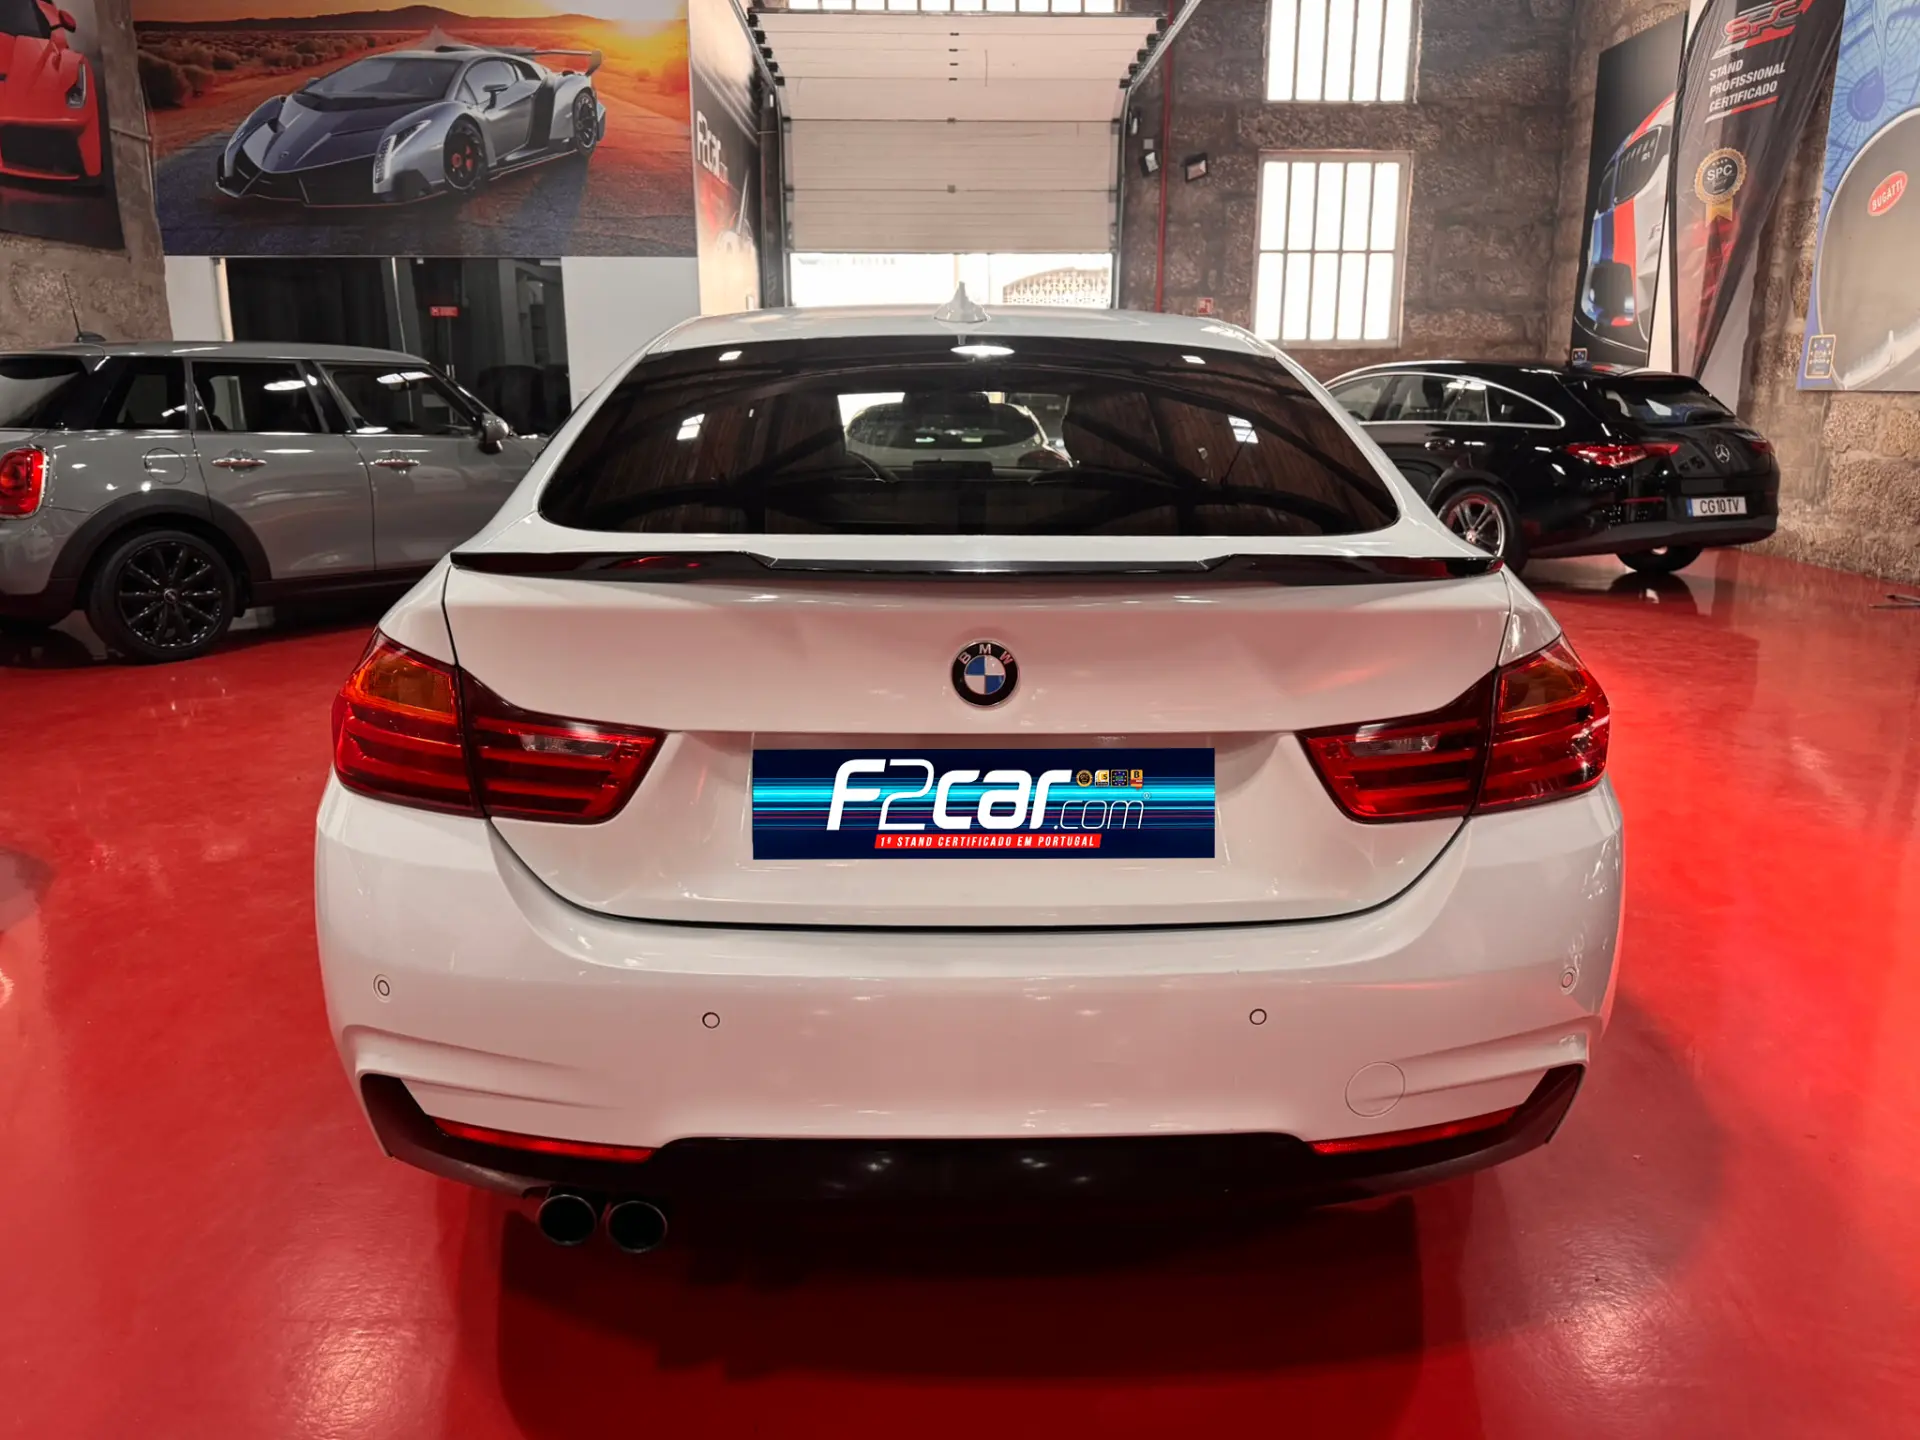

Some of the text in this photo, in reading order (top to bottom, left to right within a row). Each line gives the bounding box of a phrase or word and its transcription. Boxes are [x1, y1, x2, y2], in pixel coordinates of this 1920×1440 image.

[1709, 59, 1744, 81] STAND
[1709, 62, 1786, 97] PROFISSIONAL
[1709, 80, 1778, 112] CERTIFICADO
[1707, 164, 1733, 181] SPC
[1872, 178, 1903, 211] BUGATTI
[1700, 499, 1739, 514] CG10TV
[958, 643, 1014, 665] BMW
